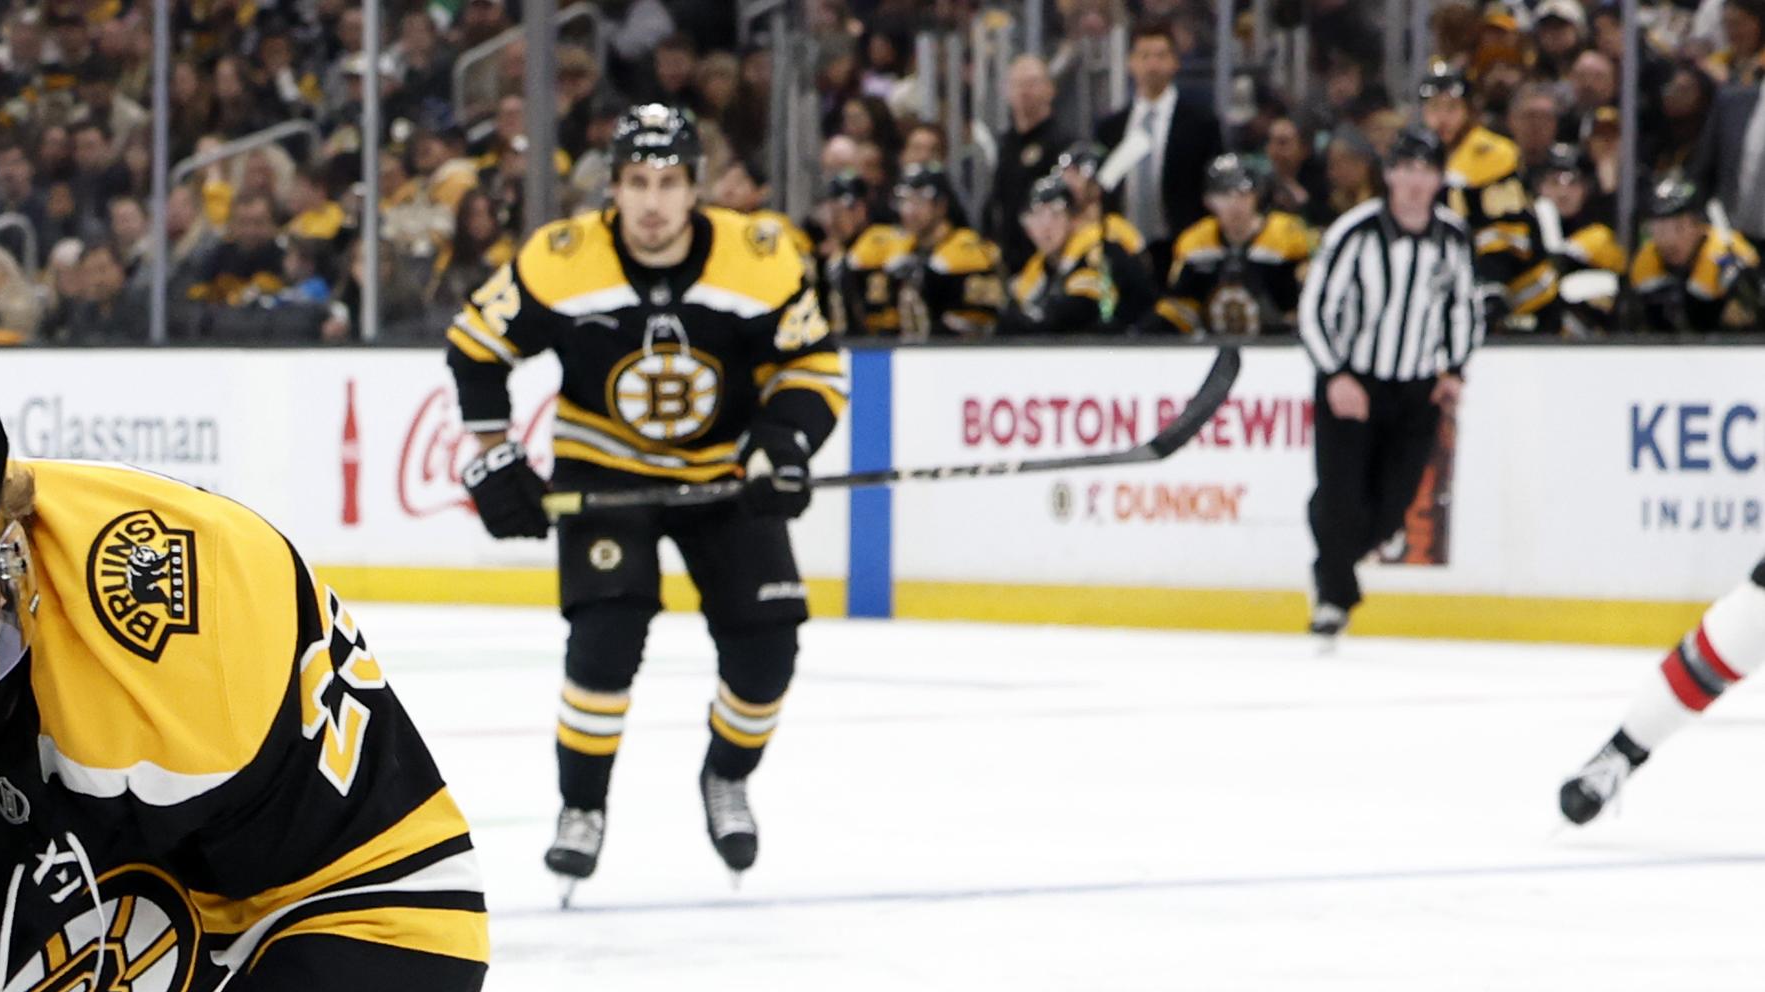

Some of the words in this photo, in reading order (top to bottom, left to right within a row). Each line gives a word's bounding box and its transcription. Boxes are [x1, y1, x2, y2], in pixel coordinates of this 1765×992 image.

[961, 398, 1138, 446] BOSTON
[1158, 398, 1317, 446] BEWI
[100, 518, 159, 643] BRUINS
